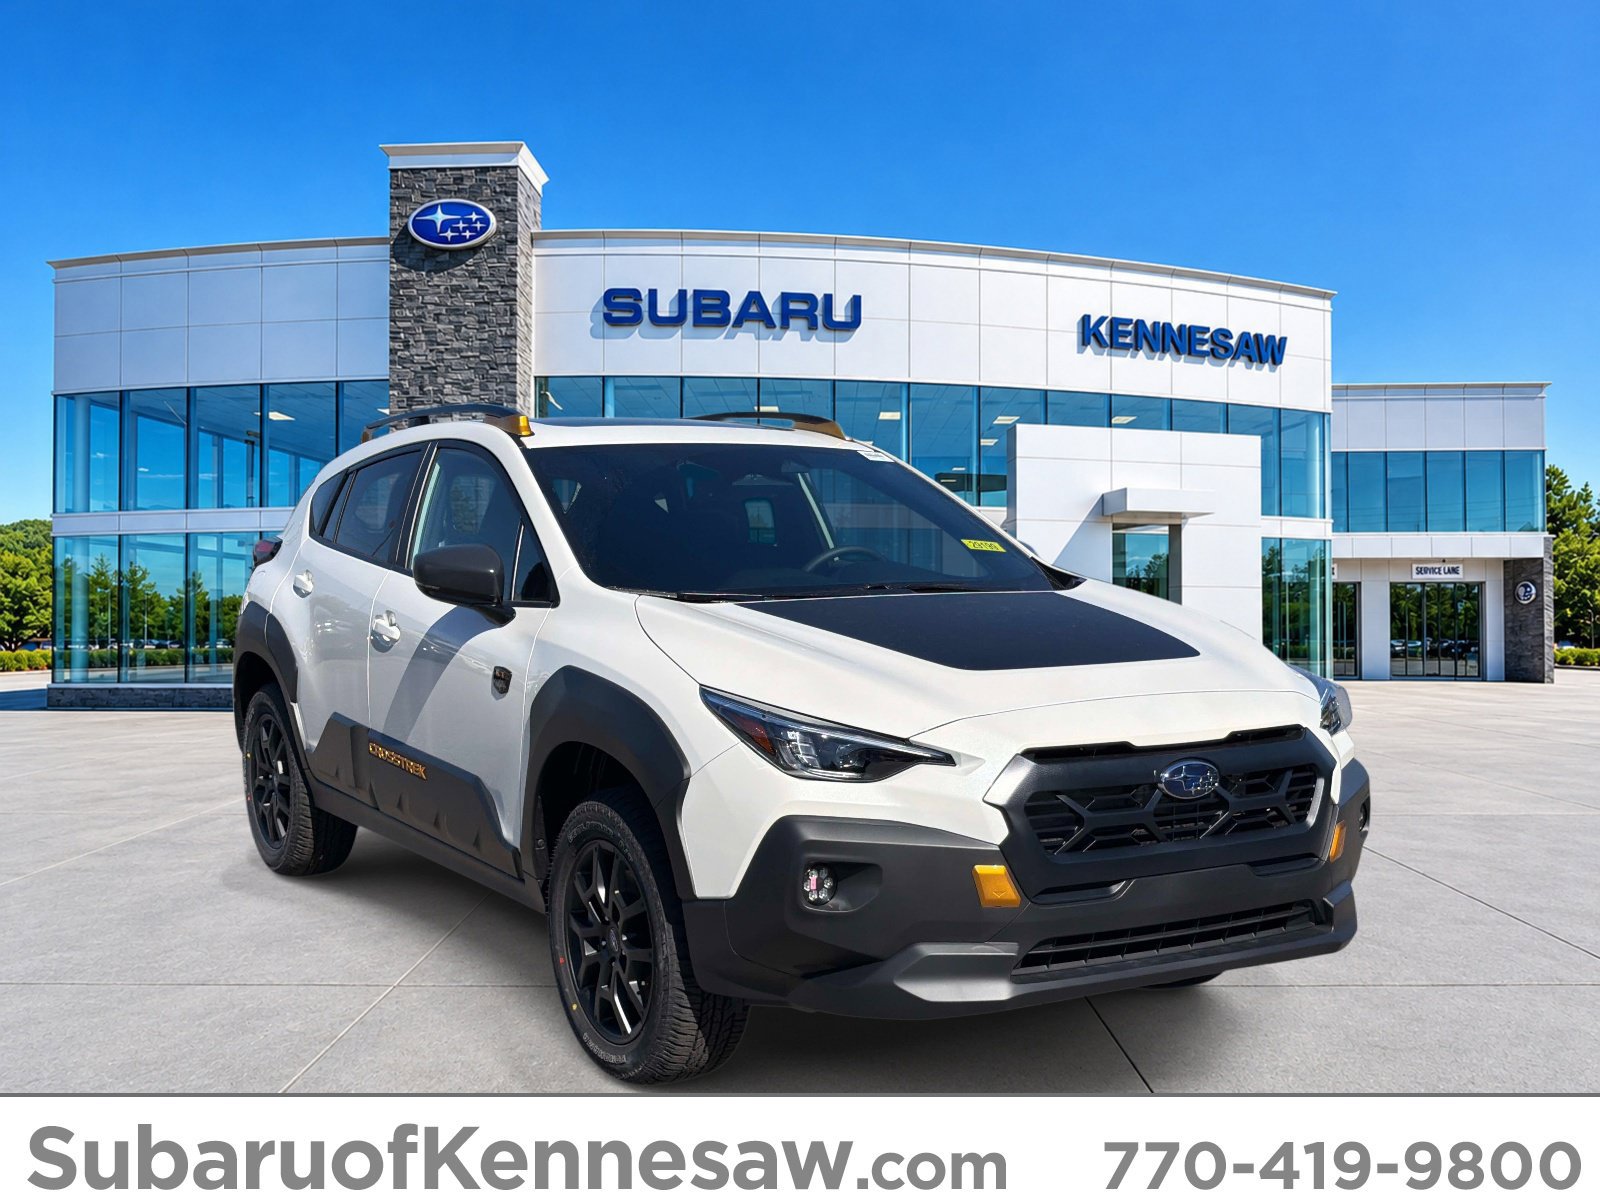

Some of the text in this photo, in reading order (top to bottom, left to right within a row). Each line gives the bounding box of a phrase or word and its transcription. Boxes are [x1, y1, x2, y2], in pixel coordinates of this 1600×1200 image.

[603, 288, 862, 330] SUBARU
[1081, 314, 1288, 366] KENNESAW
[1415, 566, 1460, 575] SERVICE LANE
[368, 742, 427, 780] CROSSTREK
